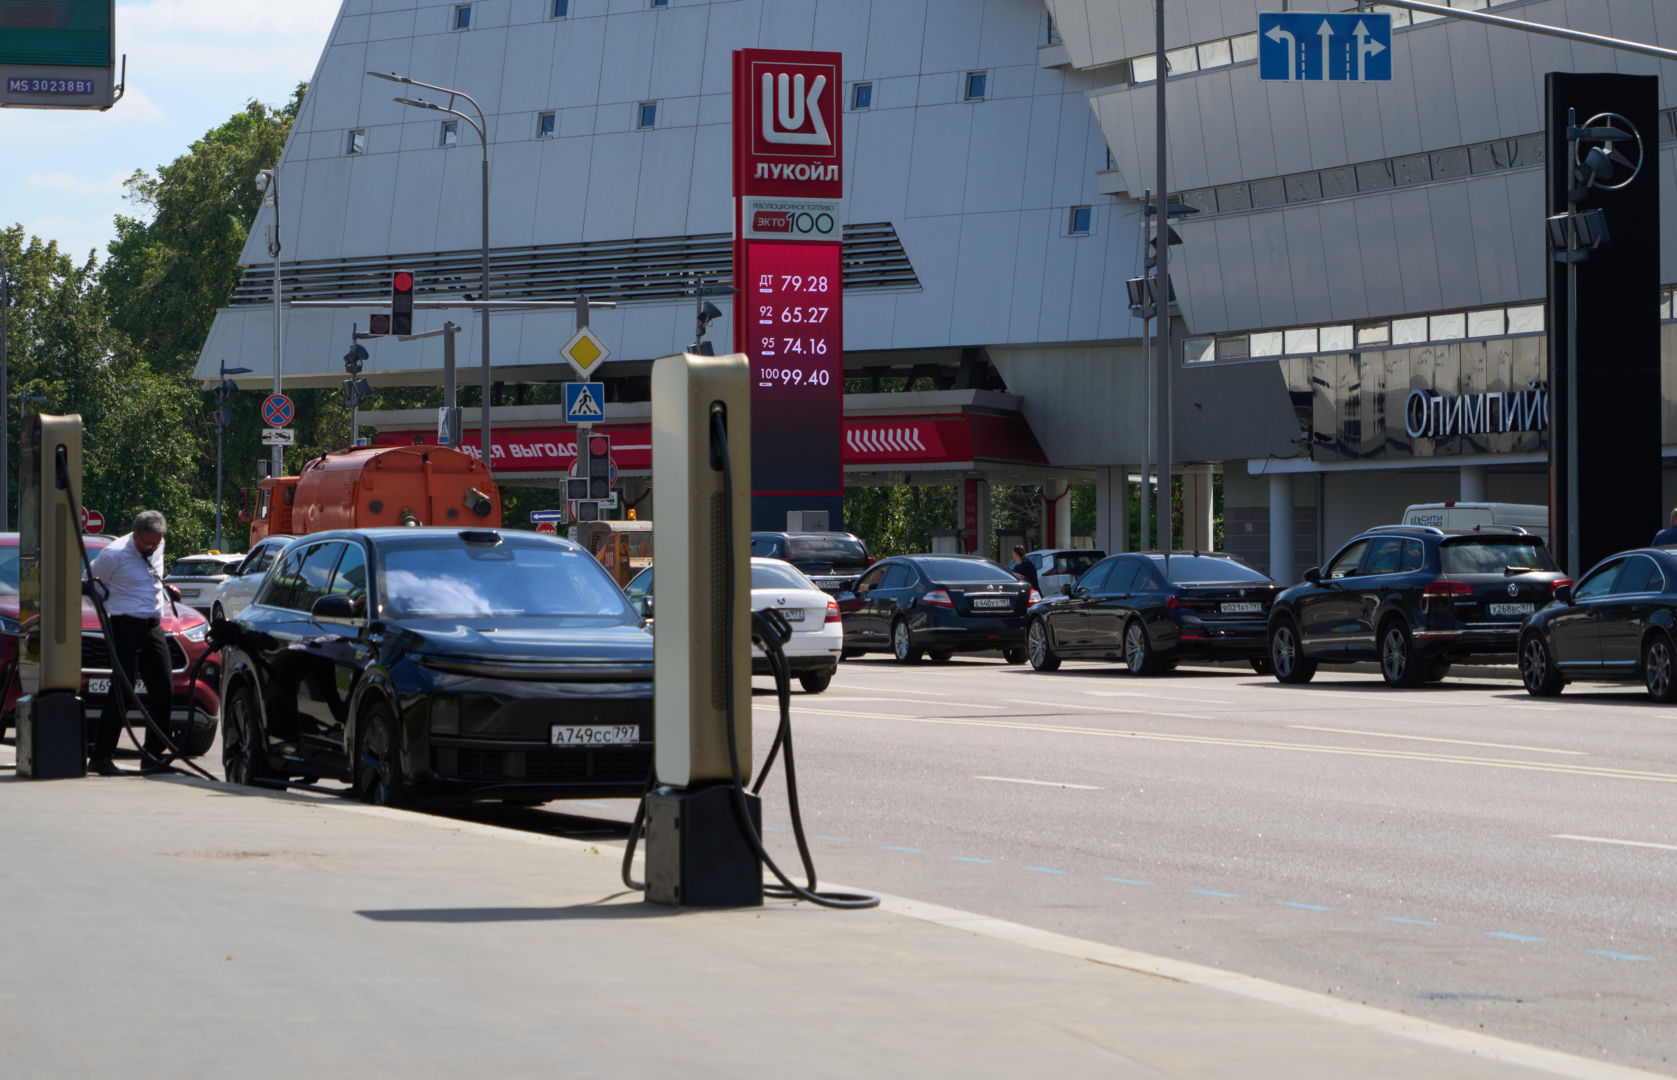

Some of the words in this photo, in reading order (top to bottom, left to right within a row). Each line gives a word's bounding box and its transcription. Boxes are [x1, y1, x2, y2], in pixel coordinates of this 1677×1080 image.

[10, 80, 29, 91] MS
[32, 80, 91, 93] 30238B1
[754, 161, 839, 182] ЛУКОЙЛ
[759, 274, 773, 287] ДТ
[781, 275, 828, 293] 79.28
[759, 305, 773, 317] 92
[781, 306, 829, 323] 65.27
[761, 337, 775, 348] 95
[783, 338, 827, 355] 74.16
[760, 368, 779, 379] 100
[781, 369, 830, 386] 99.40
